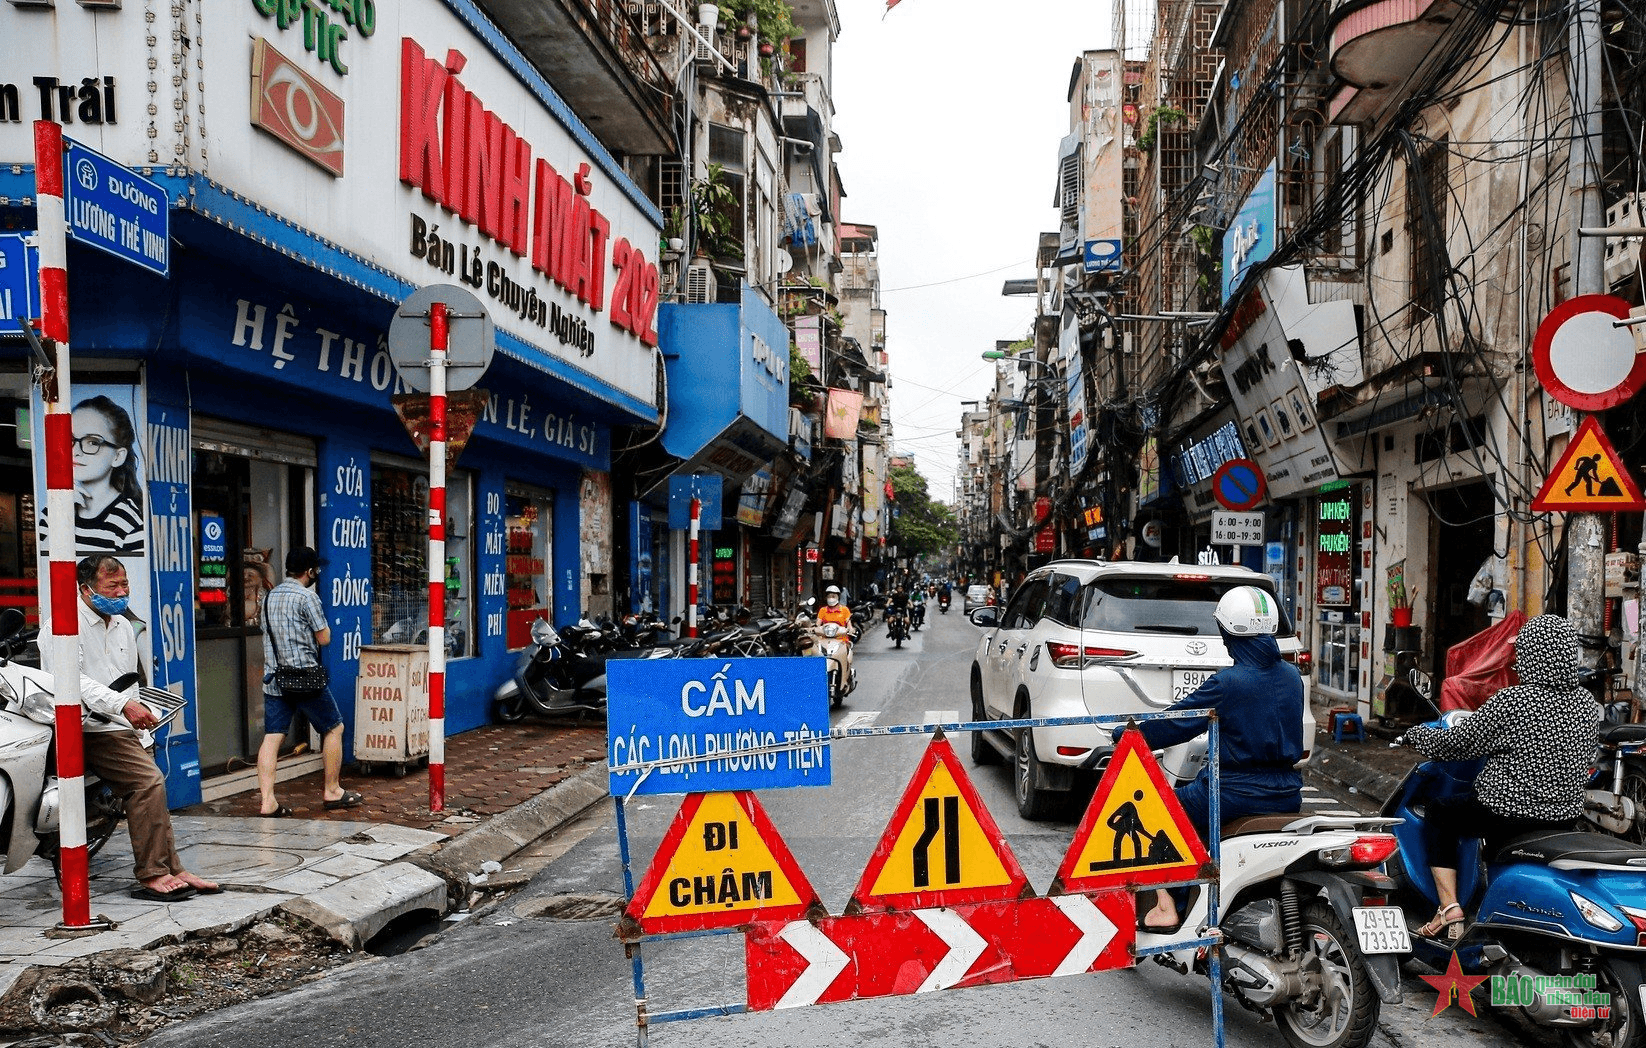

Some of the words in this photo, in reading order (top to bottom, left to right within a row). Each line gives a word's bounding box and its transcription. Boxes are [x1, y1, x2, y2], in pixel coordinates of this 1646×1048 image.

[33, 76, 117, 125] Trãi
[400, 37, 532, 258] KÍNH
[108, 175, 158, 215] ĐƯỜNG
[73, 197, 115, 242] LƯƠNG
[119, 216, 140, 254] THẾ
[142, 231, 165, 265] VINH
[410, 212, 454, 275] Bán
[459, 243, 483, 289] Lẻ
[487, 260, 546, 328] Chuyên
[550, 301, 595, 358] Nghiệp
[231, 299, 299, 370] HỆ
[544, 413, 574, 449] GIÁ
[148, 412, 188, 484] KÍNH
[335, 458, 363, 498] SỬA
[332, 516, 367, 549] CHỮA
[1218, 517, 1237, 526] 6:00
[1244, 518, 1261, 527] 9:00
[1198, 545, 1220, 566] SỬA
[332, 563, 369, 607] ĐỒNG
[162, 582, 186, 662] SỐ
[342, 616, 362, 661] HỒ
[487, 607, 502, 636] PHÍ
[362, 681, 402, 703] KHÓA
[681, 663, 766, 717] CẤM
[1183, 671, 1206, 686] 98A
[365, 730, 397, 750] NHÀ
[614, 725, 651, 776] CÁC
[658, 733, 698, 780] LOẠI
[705, 728, 777, 774] PHƯƠNG
[784, 723, 824, 777] TIỆN
[703, 821, 739, 852] ĐI
[1253, 840, 1299, 849] VISION
[669, 867, 773, 908] CHẬM
[1361, 910, 1399, 929] 29-E2
[1361, 930, 1409, 951] 733.52
